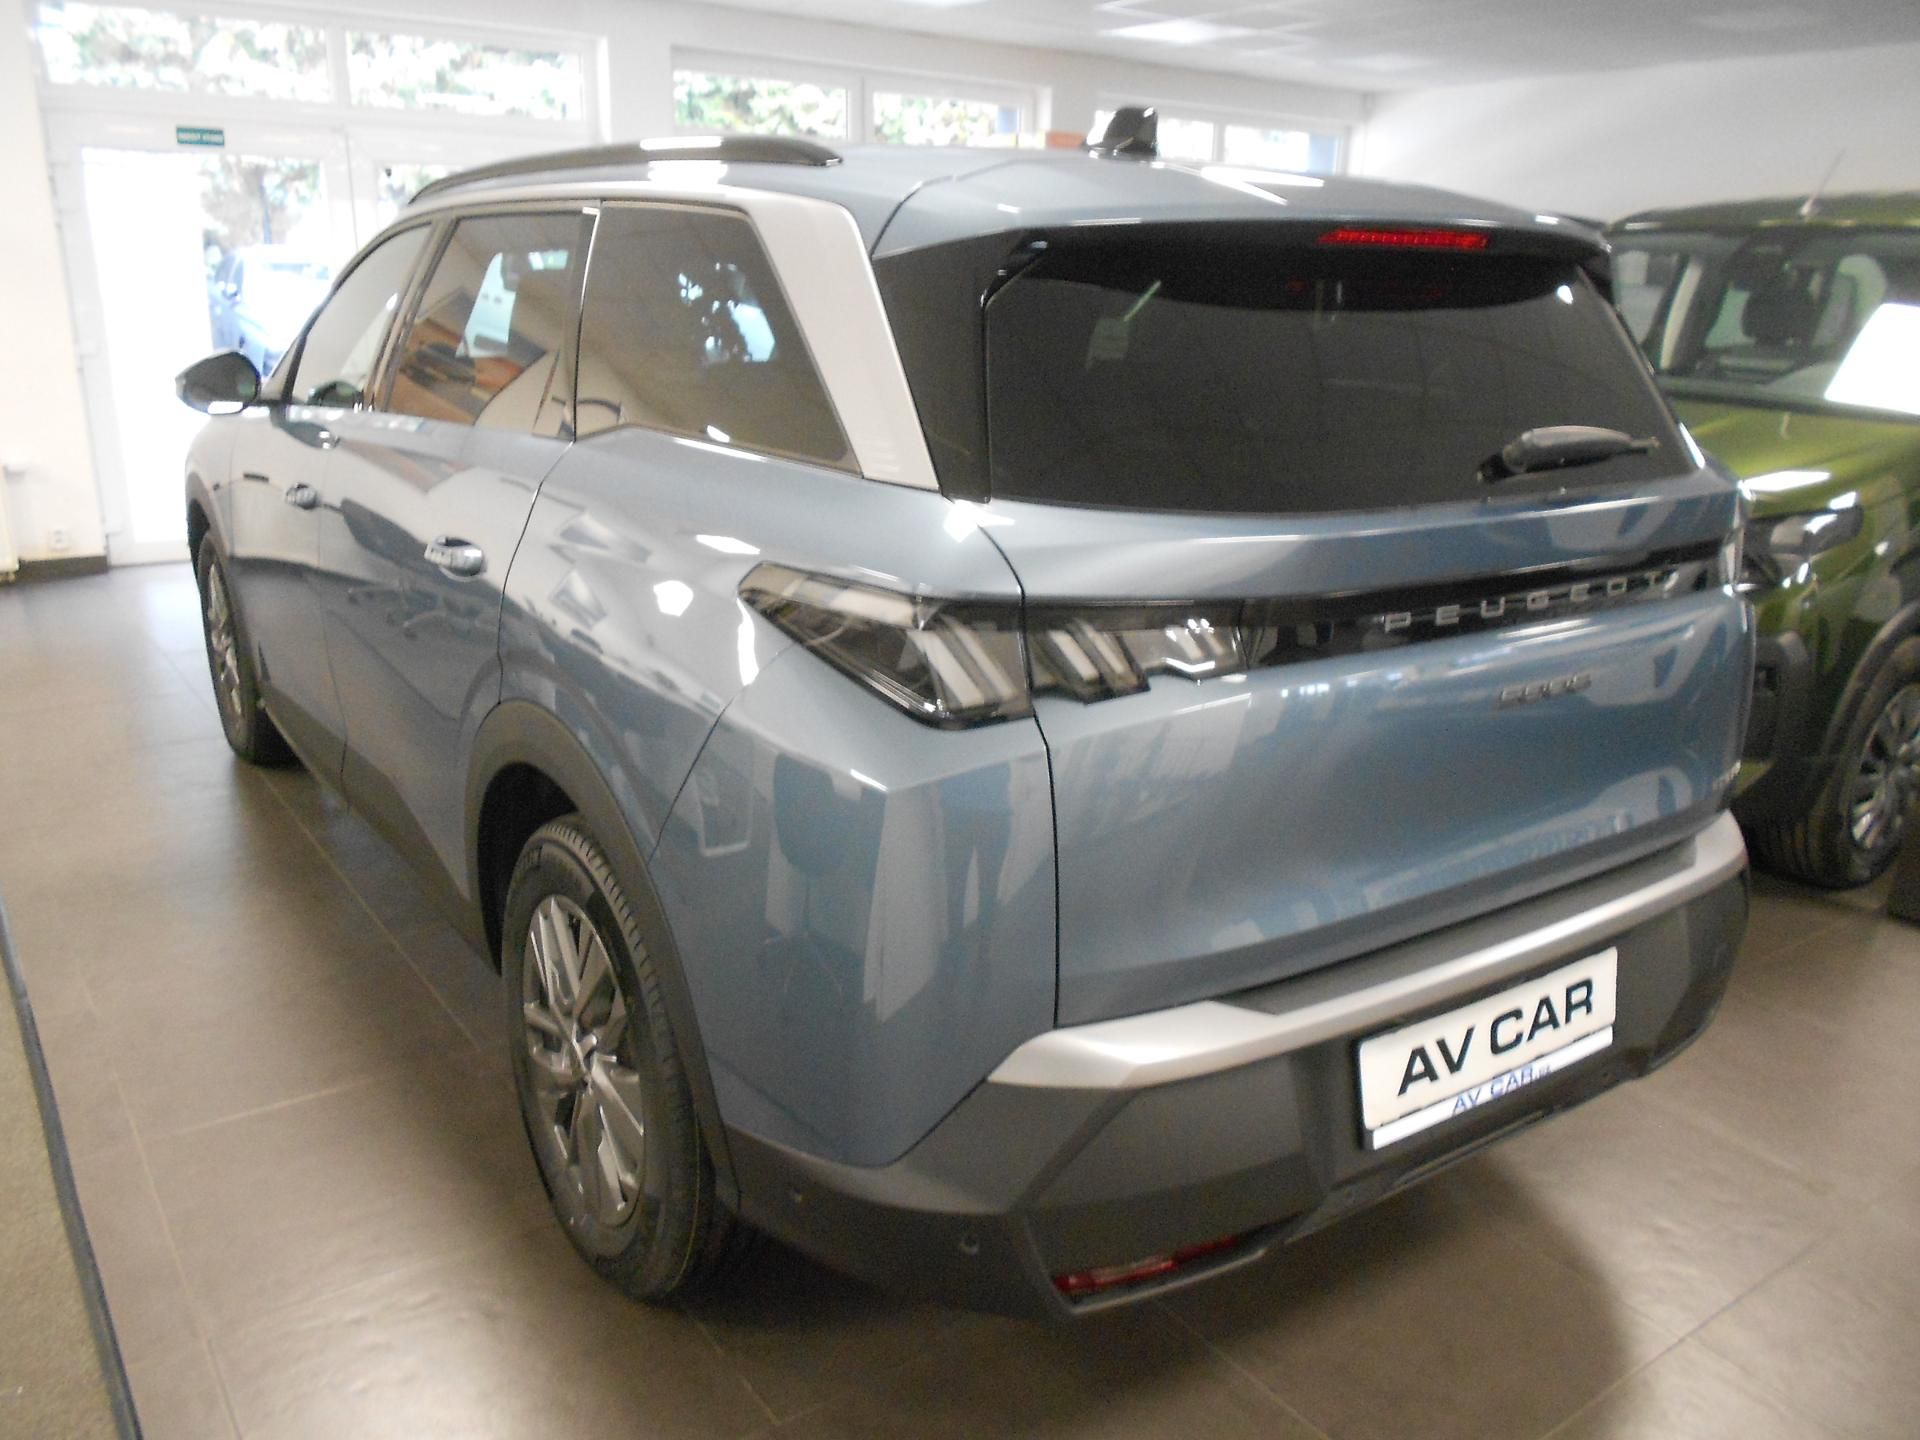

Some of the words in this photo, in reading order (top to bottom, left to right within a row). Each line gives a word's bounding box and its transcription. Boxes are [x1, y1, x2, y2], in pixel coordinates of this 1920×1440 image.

[1384, 569, 1664, 634] PEUGEOT
[1397, 1025, 1475, 1096] AV
[1489, 977, 1594, 1055] CAR
[1452, 1087, 1482, 1116] AV
